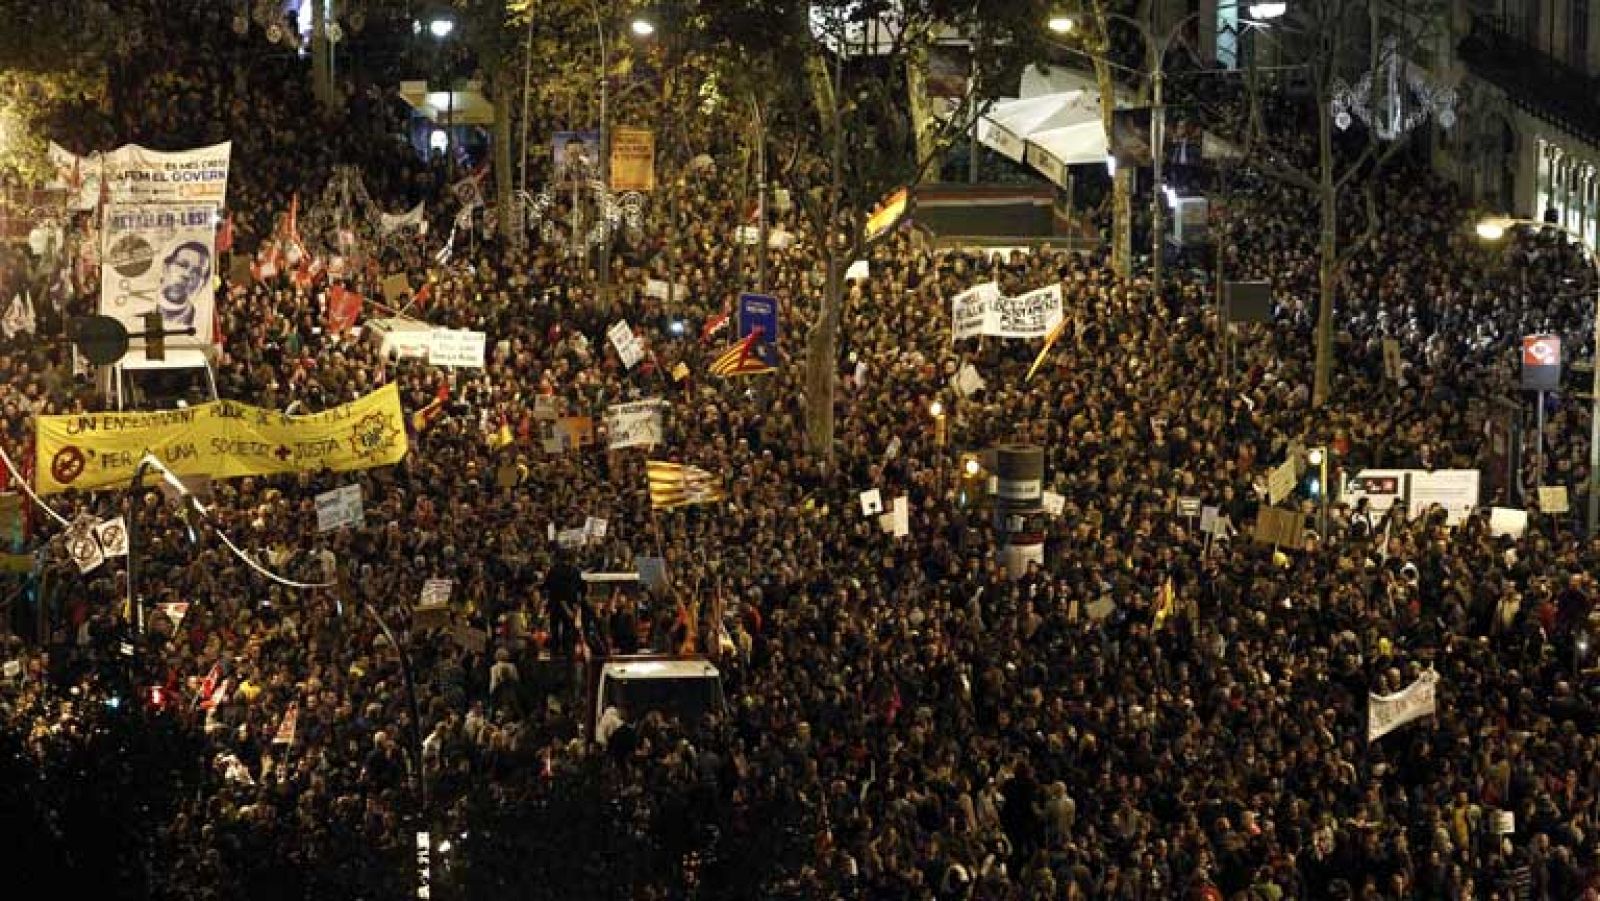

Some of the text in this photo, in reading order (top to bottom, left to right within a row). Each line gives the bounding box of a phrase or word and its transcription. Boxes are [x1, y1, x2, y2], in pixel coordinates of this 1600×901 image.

[173, 170, 226, 182] GOVERN
[67, 416, 97, 435] UN
[102, 450, 132, 468] PER
[166, 443, 198, 462] UNA
